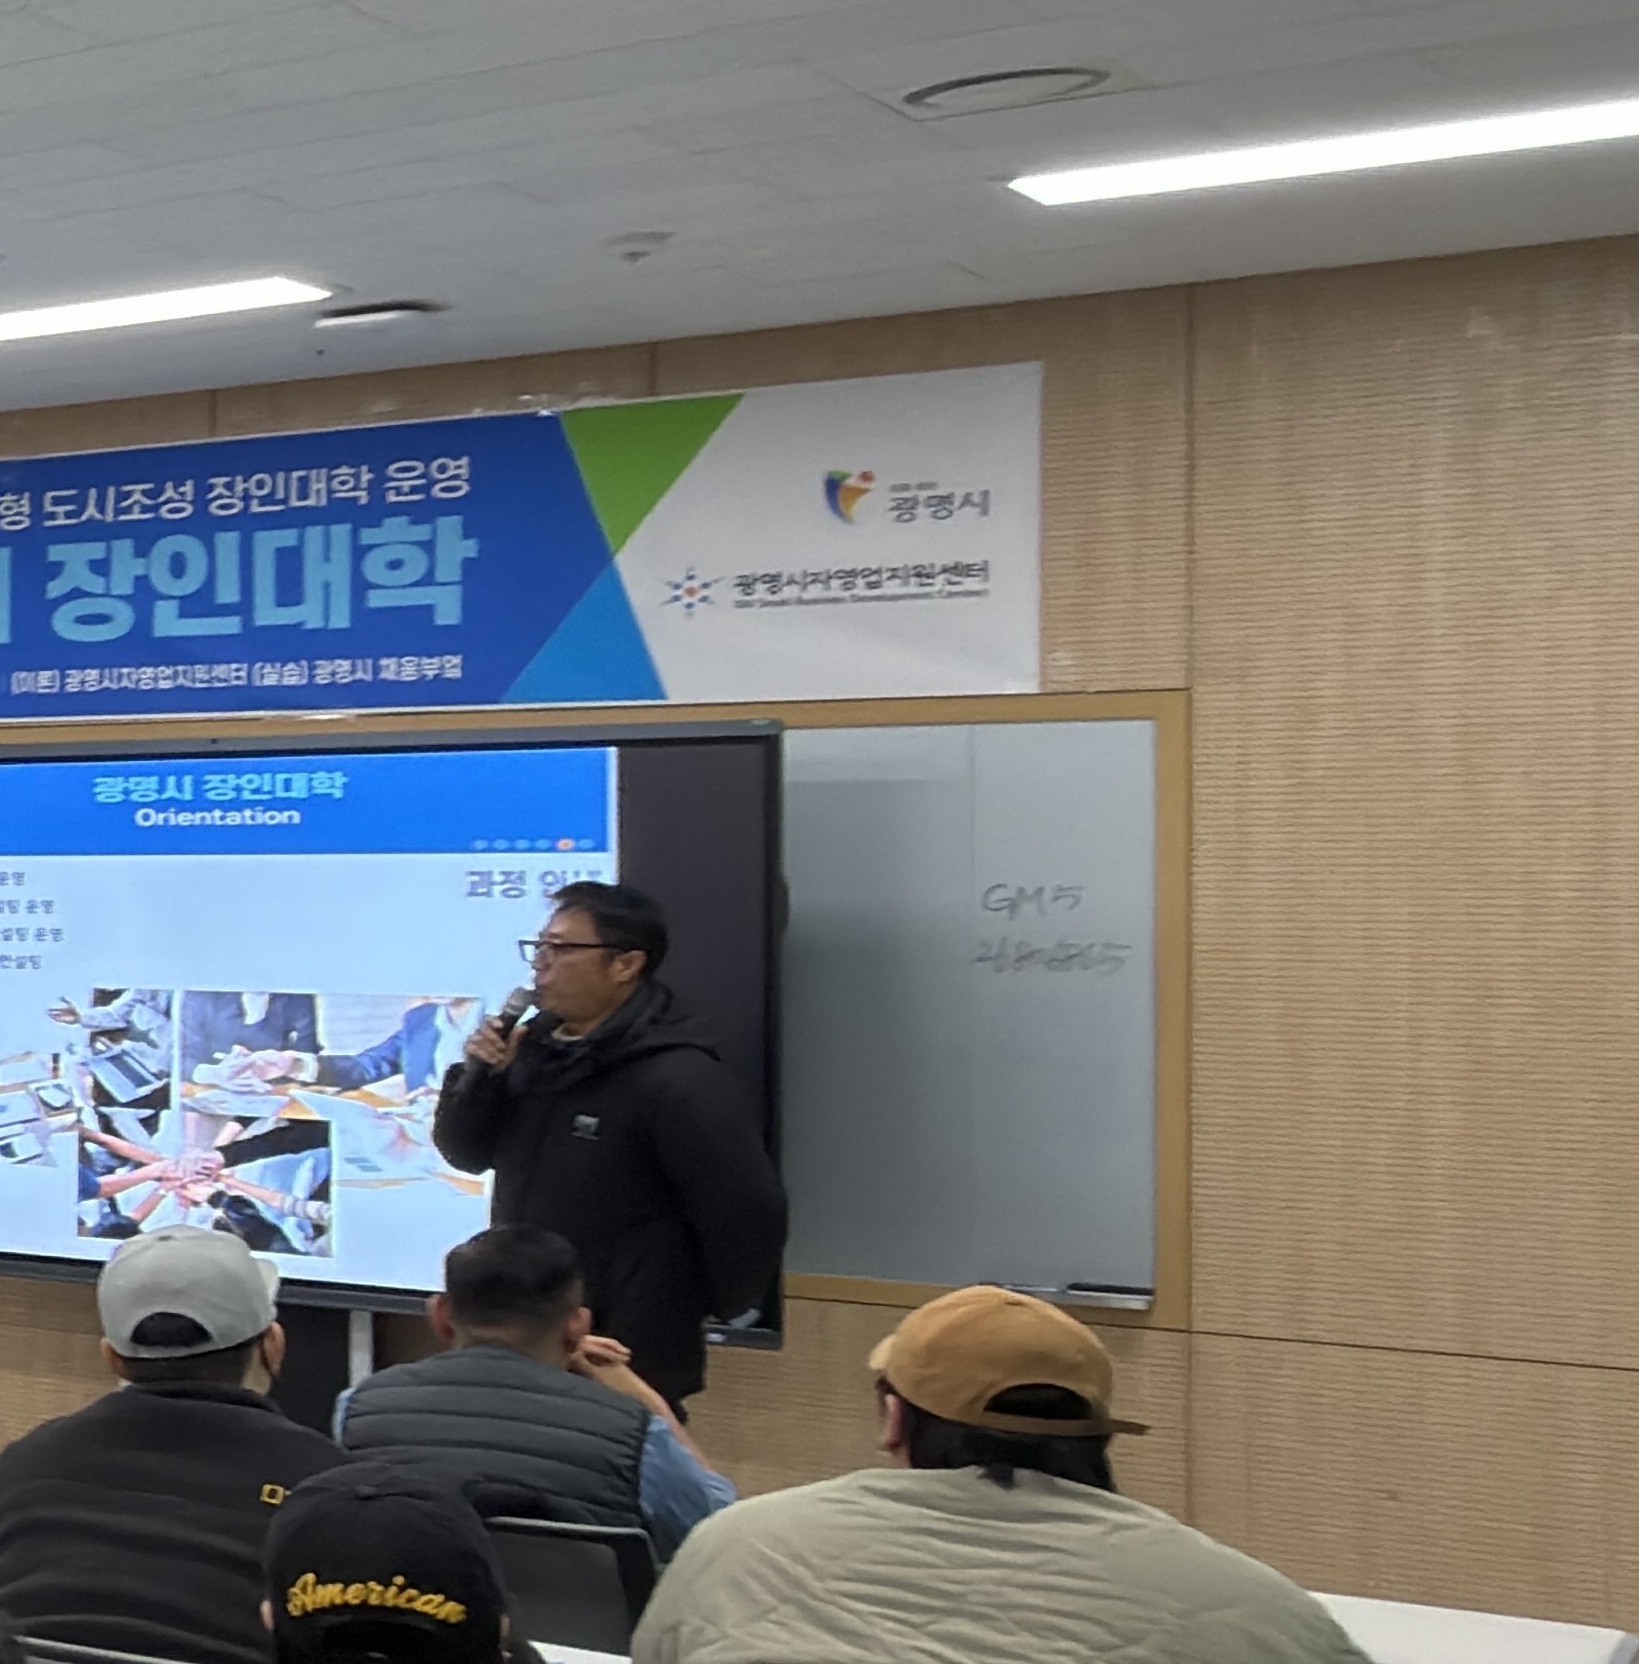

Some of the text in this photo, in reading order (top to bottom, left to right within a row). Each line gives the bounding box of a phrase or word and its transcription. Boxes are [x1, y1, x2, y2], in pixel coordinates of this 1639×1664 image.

[43, 477, 195, 527] 도시조성
[206, 465, 374, 516] 장인대학
[384, 455, 471, 502] 운영
[887, 489, 991, 523] 광명시
[45, 515, 480, 642] 장인대학
[734, 560, 989, 596] 광명시자영업지원센터
[64, 663, 248, 692] 광명시자영업지원센터
[313, 658, 373, 684] 광명시
[93, 771, 347, 803] 광명시 장인대학
[134, 807, 301, 828] Orientation
[465, 870, 602, 899] 과정 안
[287, 1572, 467, 1623] American
